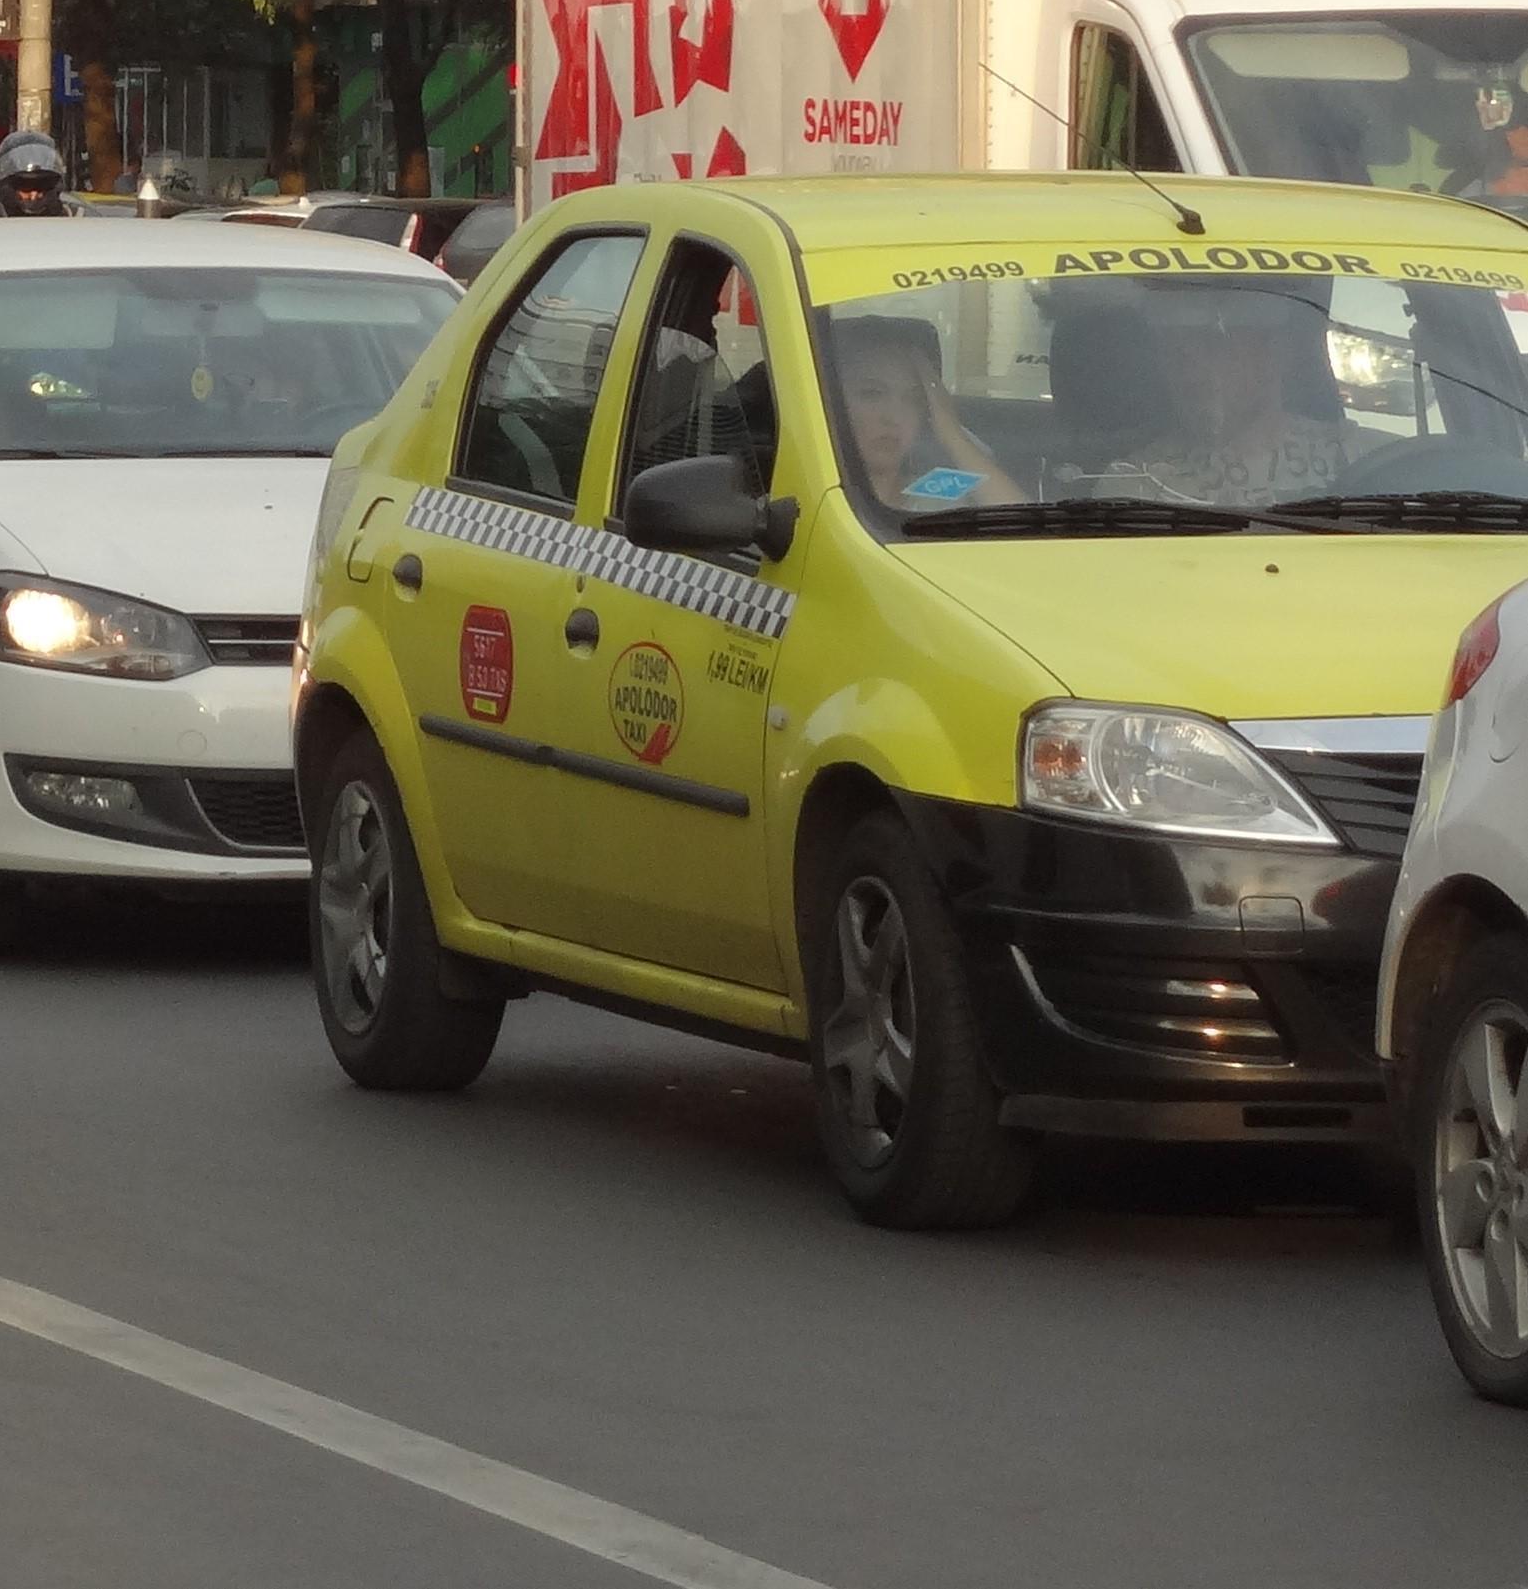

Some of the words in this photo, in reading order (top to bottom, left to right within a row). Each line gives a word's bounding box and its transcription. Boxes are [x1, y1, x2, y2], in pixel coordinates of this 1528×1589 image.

[803, 97, 903, 147] SAMEDAY
[892, 260, 1026, 290] 0219499
[1054, 247, 1379, 276] APOLODOR
[1400, 263, 1525, 290] 0219499
[614, 687, 678, 724] APOLODOR
[623, 719, 647, 745] TAXI
